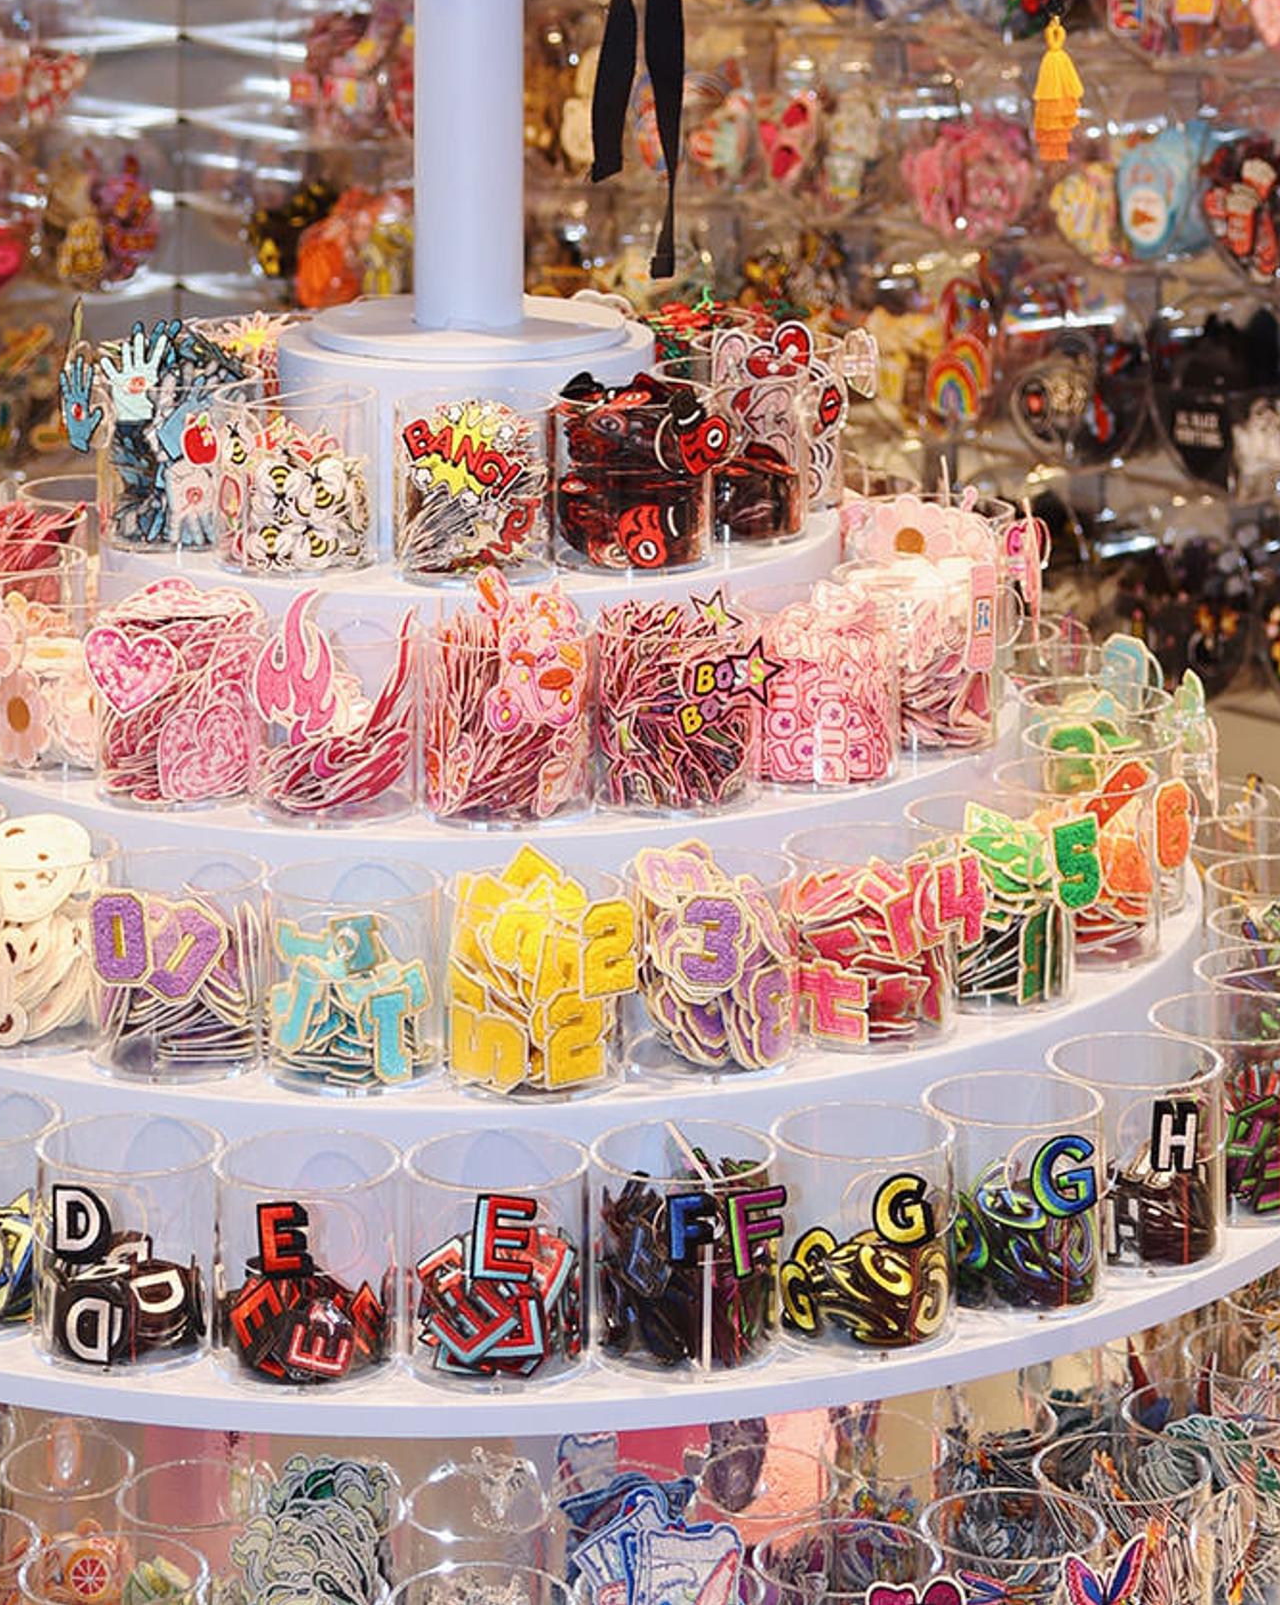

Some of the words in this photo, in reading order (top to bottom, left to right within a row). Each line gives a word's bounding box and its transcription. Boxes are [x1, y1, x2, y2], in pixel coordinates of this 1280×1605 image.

[404, 419, 523, 496] BANG!
[694, 655, 766, 695] BOSS
[680, 697, 732, 736] BO
[936, 855, 984, 942] 4
[1054, 817, 1101, 907] 5
[583, 899, 635, 996] 2
[680, 896, 742, 988] 3
[1032, 1135, 1097, 1217] G
[1155, 1107, 1198, 1172] H
[54, 1186, 107, 1258] D
[259, 1204, 304, 1276] E
[473, 1194, 536, 1281] E
[670, 1194, 712, 1262] F
[728, 1187, 786, 1278] F
[874, 1174, 928, 1244] G
